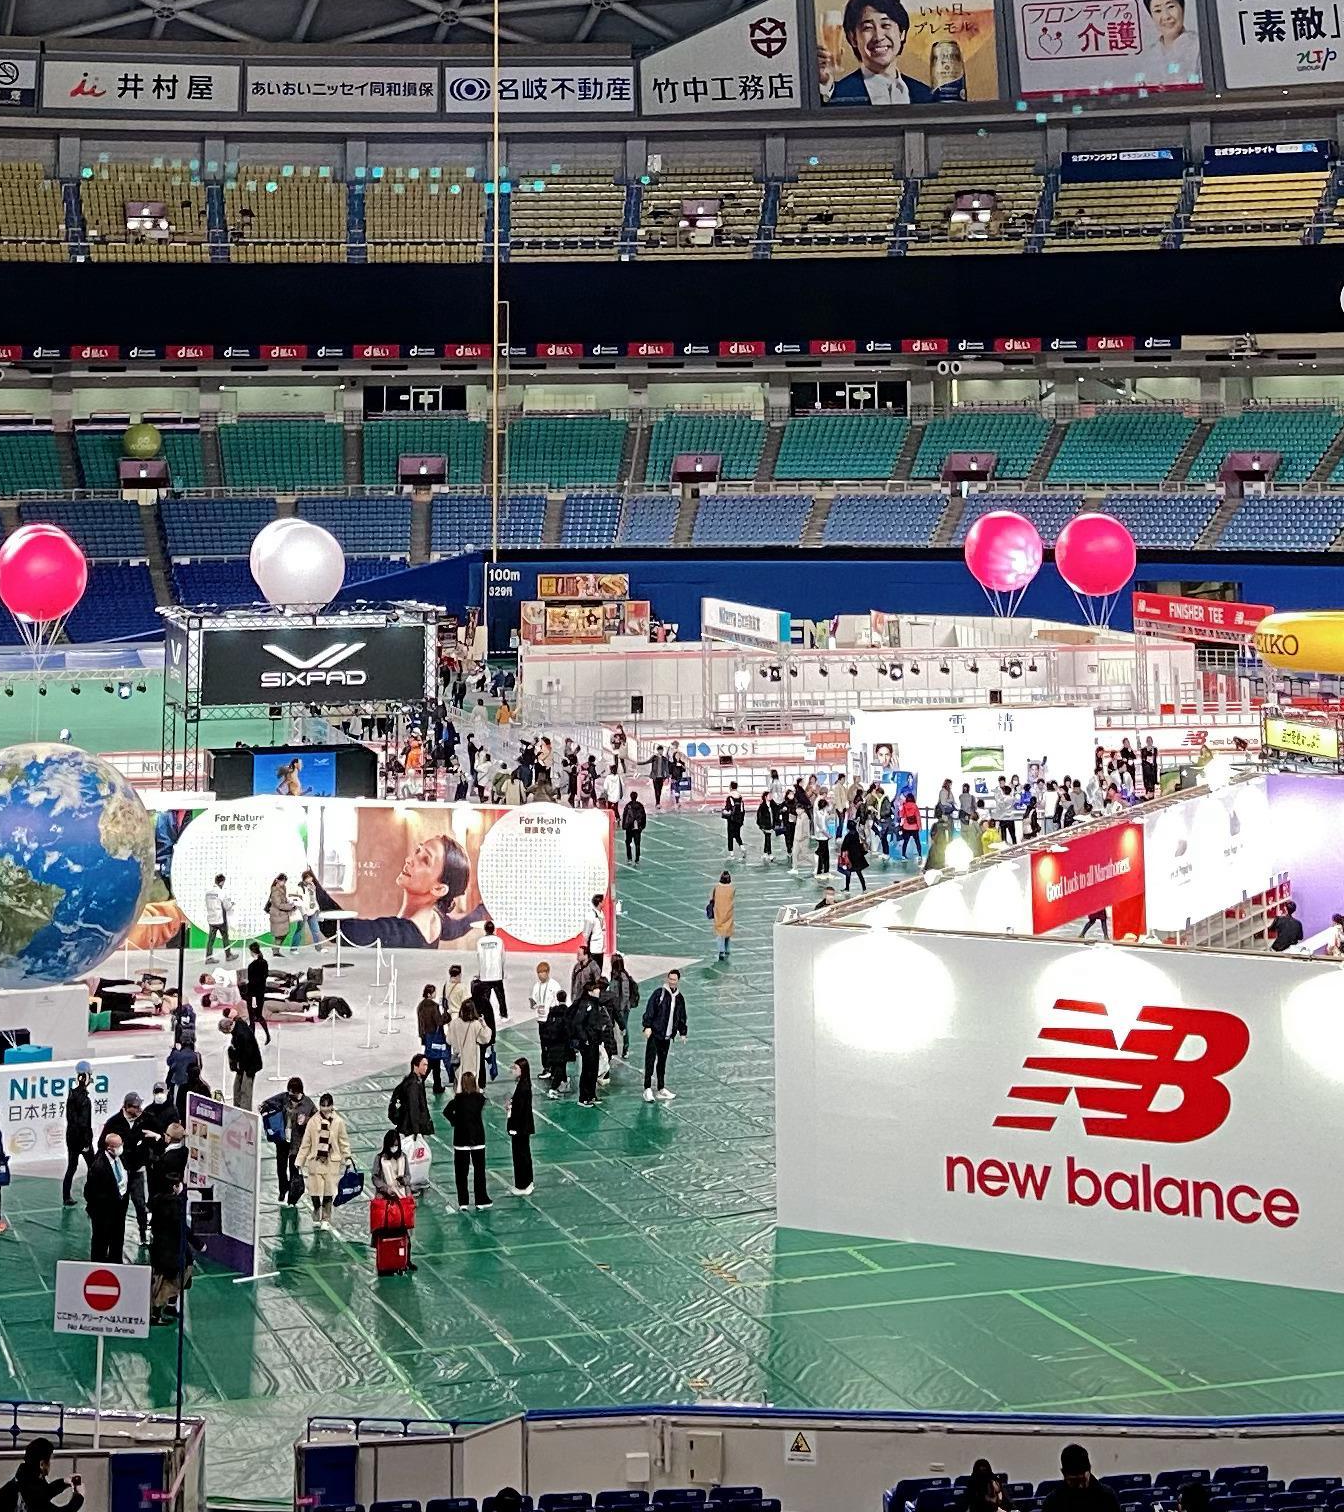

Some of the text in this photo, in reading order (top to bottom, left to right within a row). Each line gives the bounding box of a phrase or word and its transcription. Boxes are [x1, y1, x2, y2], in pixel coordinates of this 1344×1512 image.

[1026, 3, 1135, 26] フロンティアの
[1077, 19, 1138, 53] 介護
[117, 73, 213, 100] 井村屋
[251, 80, 434, 98] あいおいニッセイ同和損保
[497, 76, 632, 102] 名岐不動産
[653, 73, 794, 105] 竹中工務店
[488, 569, 521, 581] 100m
[1169, 601, 1224, 624] FINISHER TEE
[1255, 634, 1299, 657] EIKO
[260, 670, 367, 688] SIXPAD
[214, 814, 230, 822] For
[519, 816, 567, 825] For Health
[1063, 874, 1080, 896] Luck
[992, 998, 1250, 1144] NB
[9, 1074, 110, 1101] Nitera
[8, 1099, 109, 1122] 日本特業
[945, 1155, 1300, 1229] new balance
